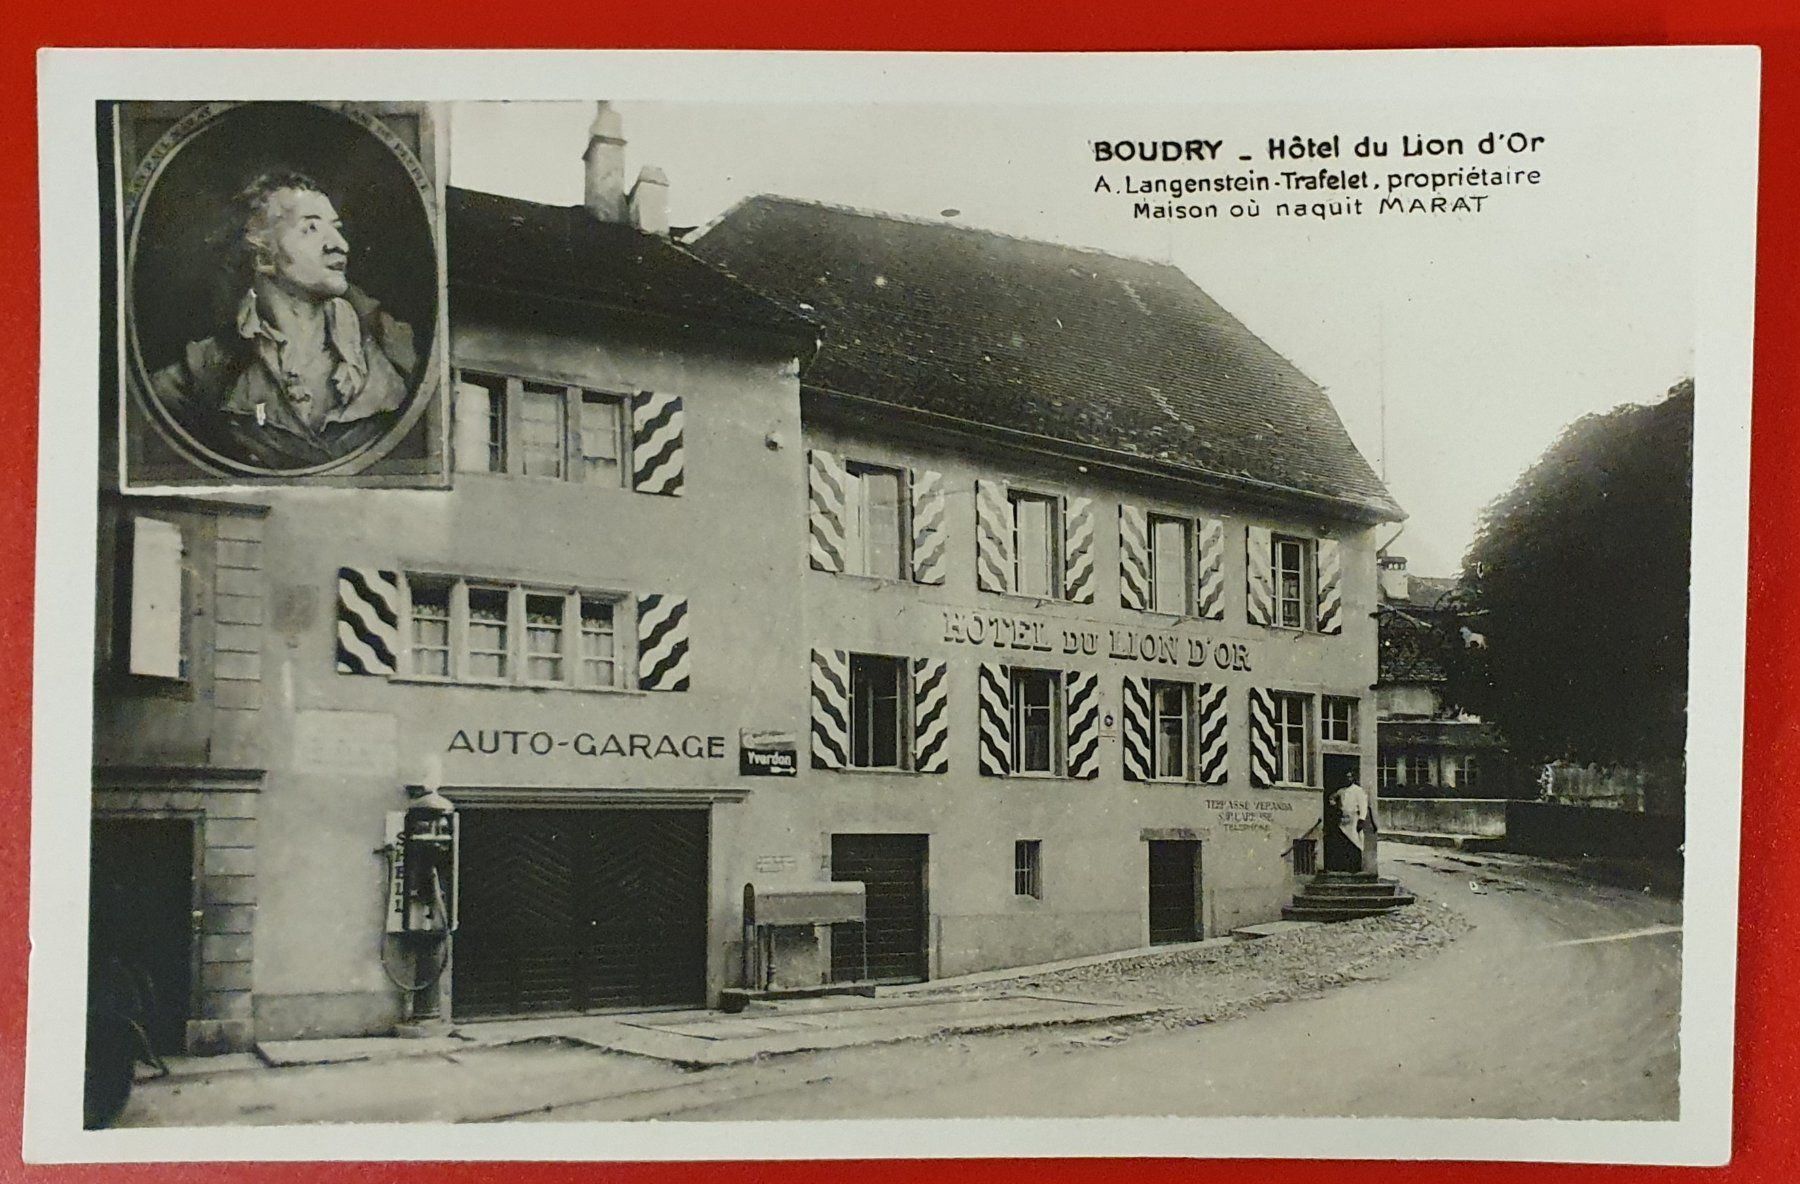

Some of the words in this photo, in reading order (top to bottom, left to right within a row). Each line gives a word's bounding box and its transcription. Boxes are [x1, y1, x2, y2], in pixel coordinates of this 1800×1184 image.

[1063, 629, 1099, 655] DU
[1109, 630, 1178, 665] LION
[1187, 638, 1252, 672] D'OR
[448, 730, 725, 760] AUTO-GARAGE
